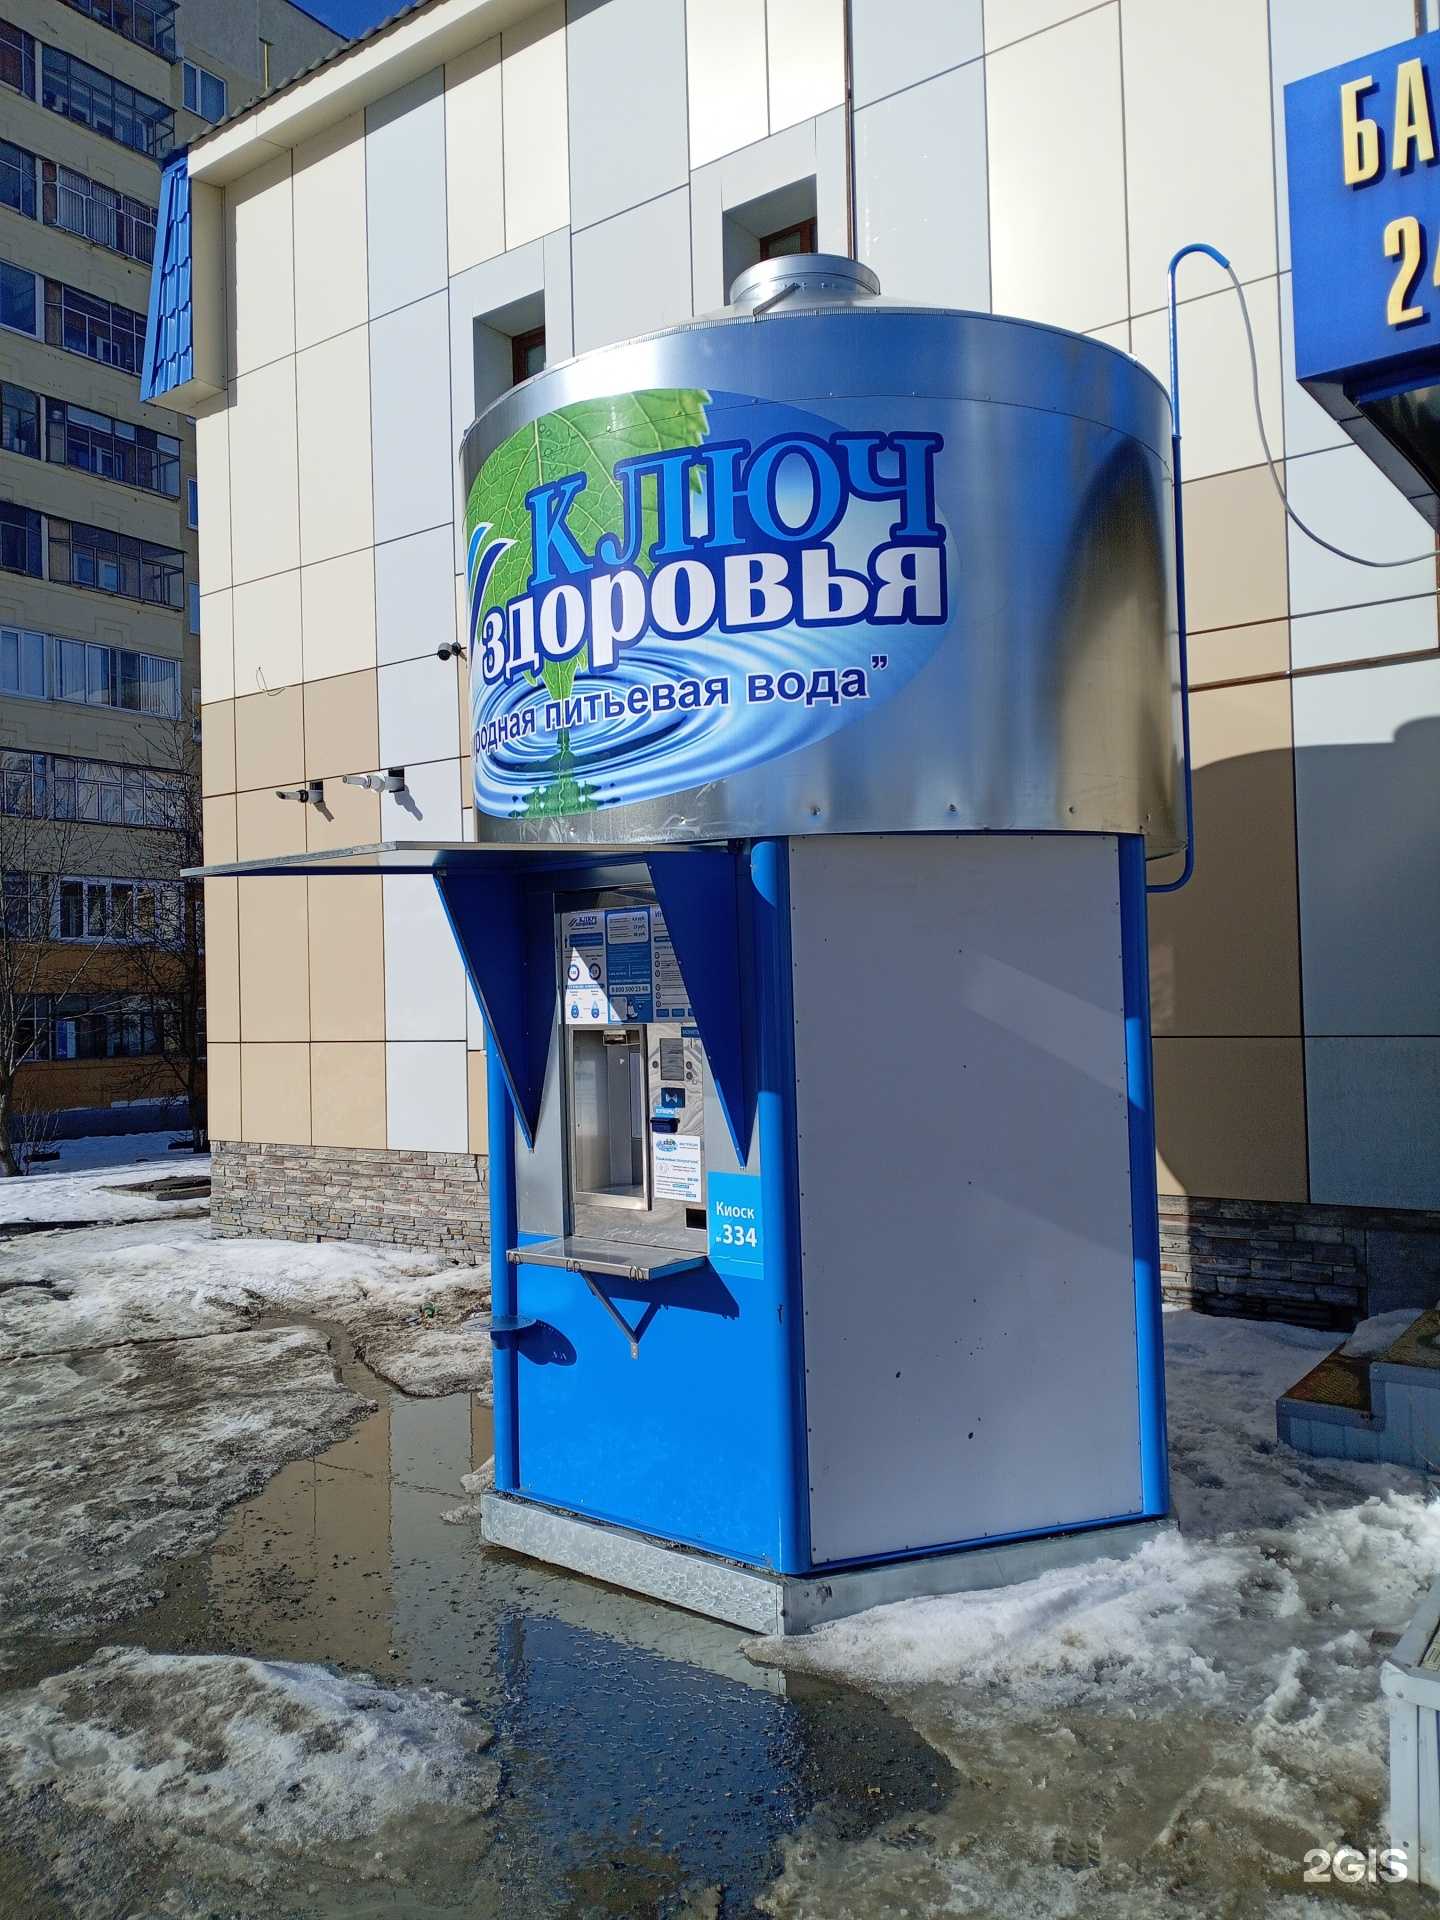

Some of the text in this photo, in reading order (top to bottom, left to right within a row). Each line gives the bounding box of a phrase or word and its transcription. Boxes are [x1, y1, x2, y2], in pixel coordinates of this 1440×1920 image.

[1340, 57, 1434, 186] БА
[544, 677, 729, 731] питьевая
[716, 1201, 755, 1219] Киоск
